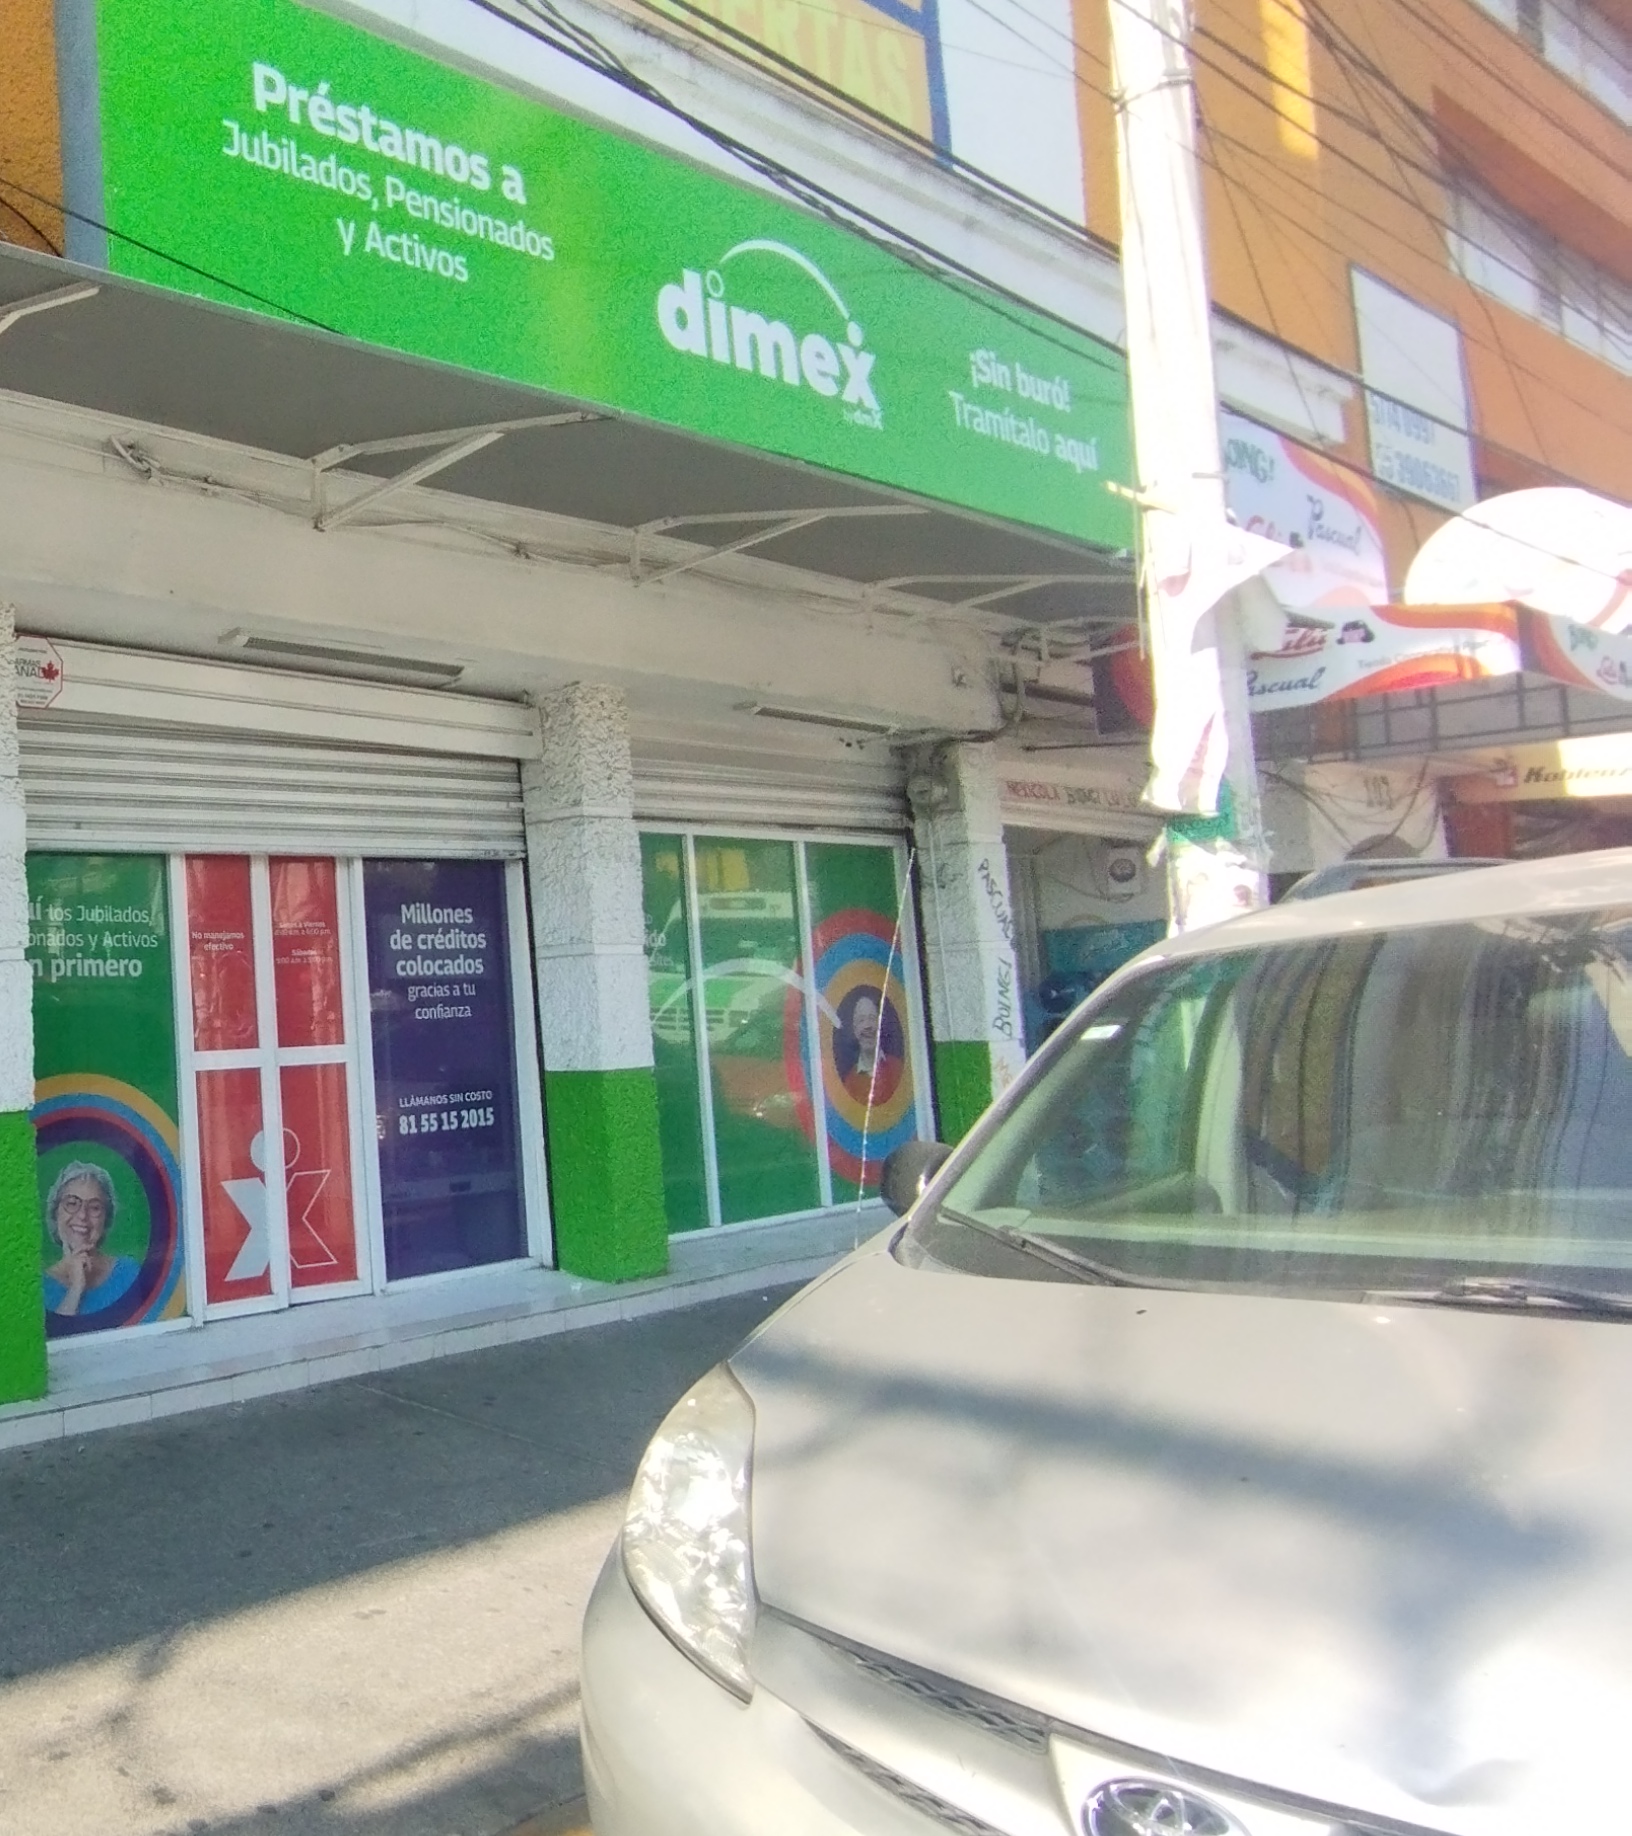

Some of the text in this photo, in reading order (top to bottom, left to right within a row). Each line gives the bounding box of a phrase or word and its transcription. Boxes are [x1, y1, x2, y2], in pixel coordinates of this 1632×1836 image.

[253, 61, 527, 205] Préstamos a
[222, 119, 555, 261] Jubilados, Pensionados
[337, 217, 468, 283] y Activos
[657, 267, 882, 412] dimex
[1016, 361, 1072, 413] buró!
[949, 391, 1099, 474] Tramítalo aquí
[49, 903, 73, 922] los
[76, 905, 152, 926] Jubilados,
[401, 903, 473, 924] Millones
[29, 930, 158, 951] onados y Activos
[192, 931, 245, 941] No manejamos
[204, 942, 234, 951] efectivo
[390, 928, 487, 950] de créditos
[50, 952, 143, 983] primero
[396, 955, 484, 977] colocados
[407, 982, 476, 1001] gracias a tu
[415, 1005, 472, 1019] confianza
[449, 1093, 464, 1104] SIN
[465, 1090, 493, 1102] COSTO
[399, 1106, 495, 1135] 81 55 15 2015
